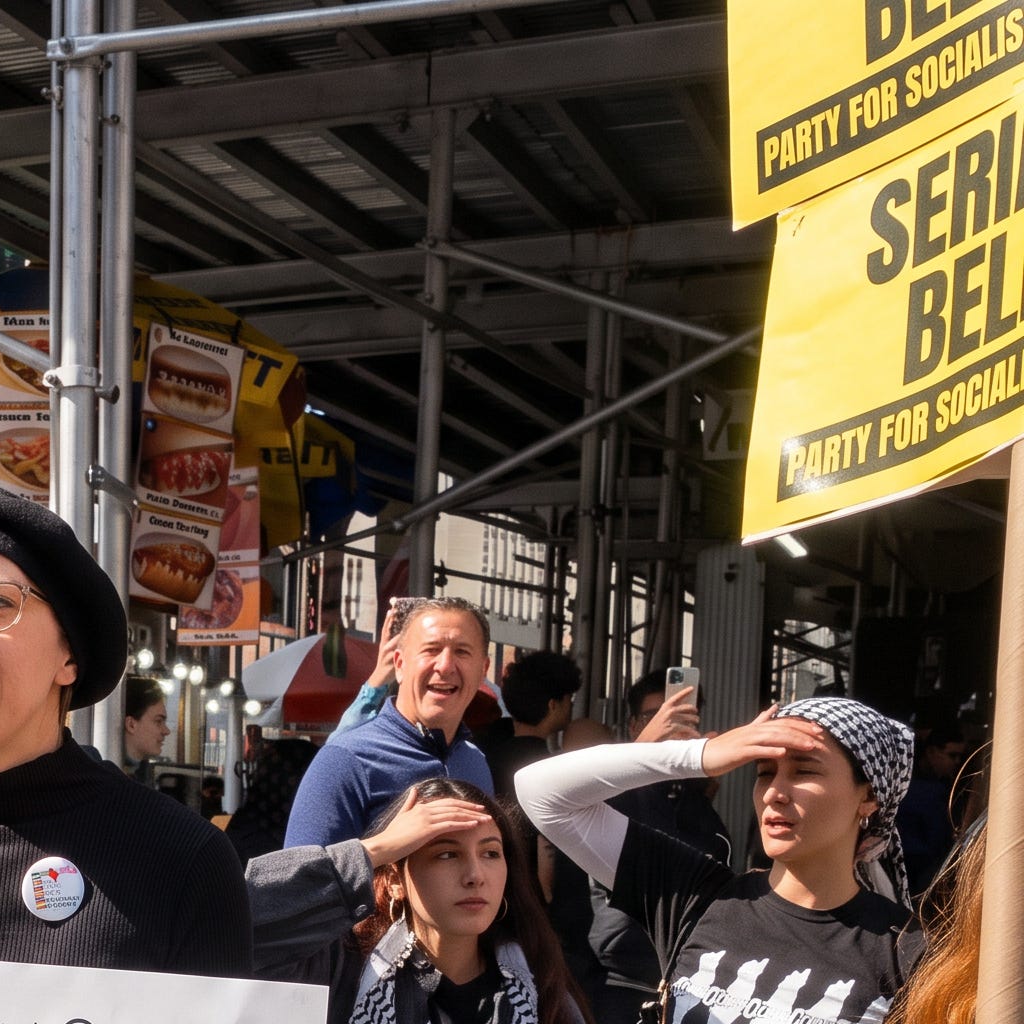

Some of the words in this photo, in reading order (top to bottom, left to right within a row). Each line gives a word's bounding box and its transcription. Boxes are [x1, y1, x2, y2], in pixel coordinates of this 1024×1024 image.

[764, 104, 840, 178] PARTY
[848, 77, 898, 138] FOR
[866, 111, 1024, 285] SERI
[902, 230, 1024, 386] BEL
[785, 422, 873, 487] PARTY
[878, 401, 929, 458] FOR
